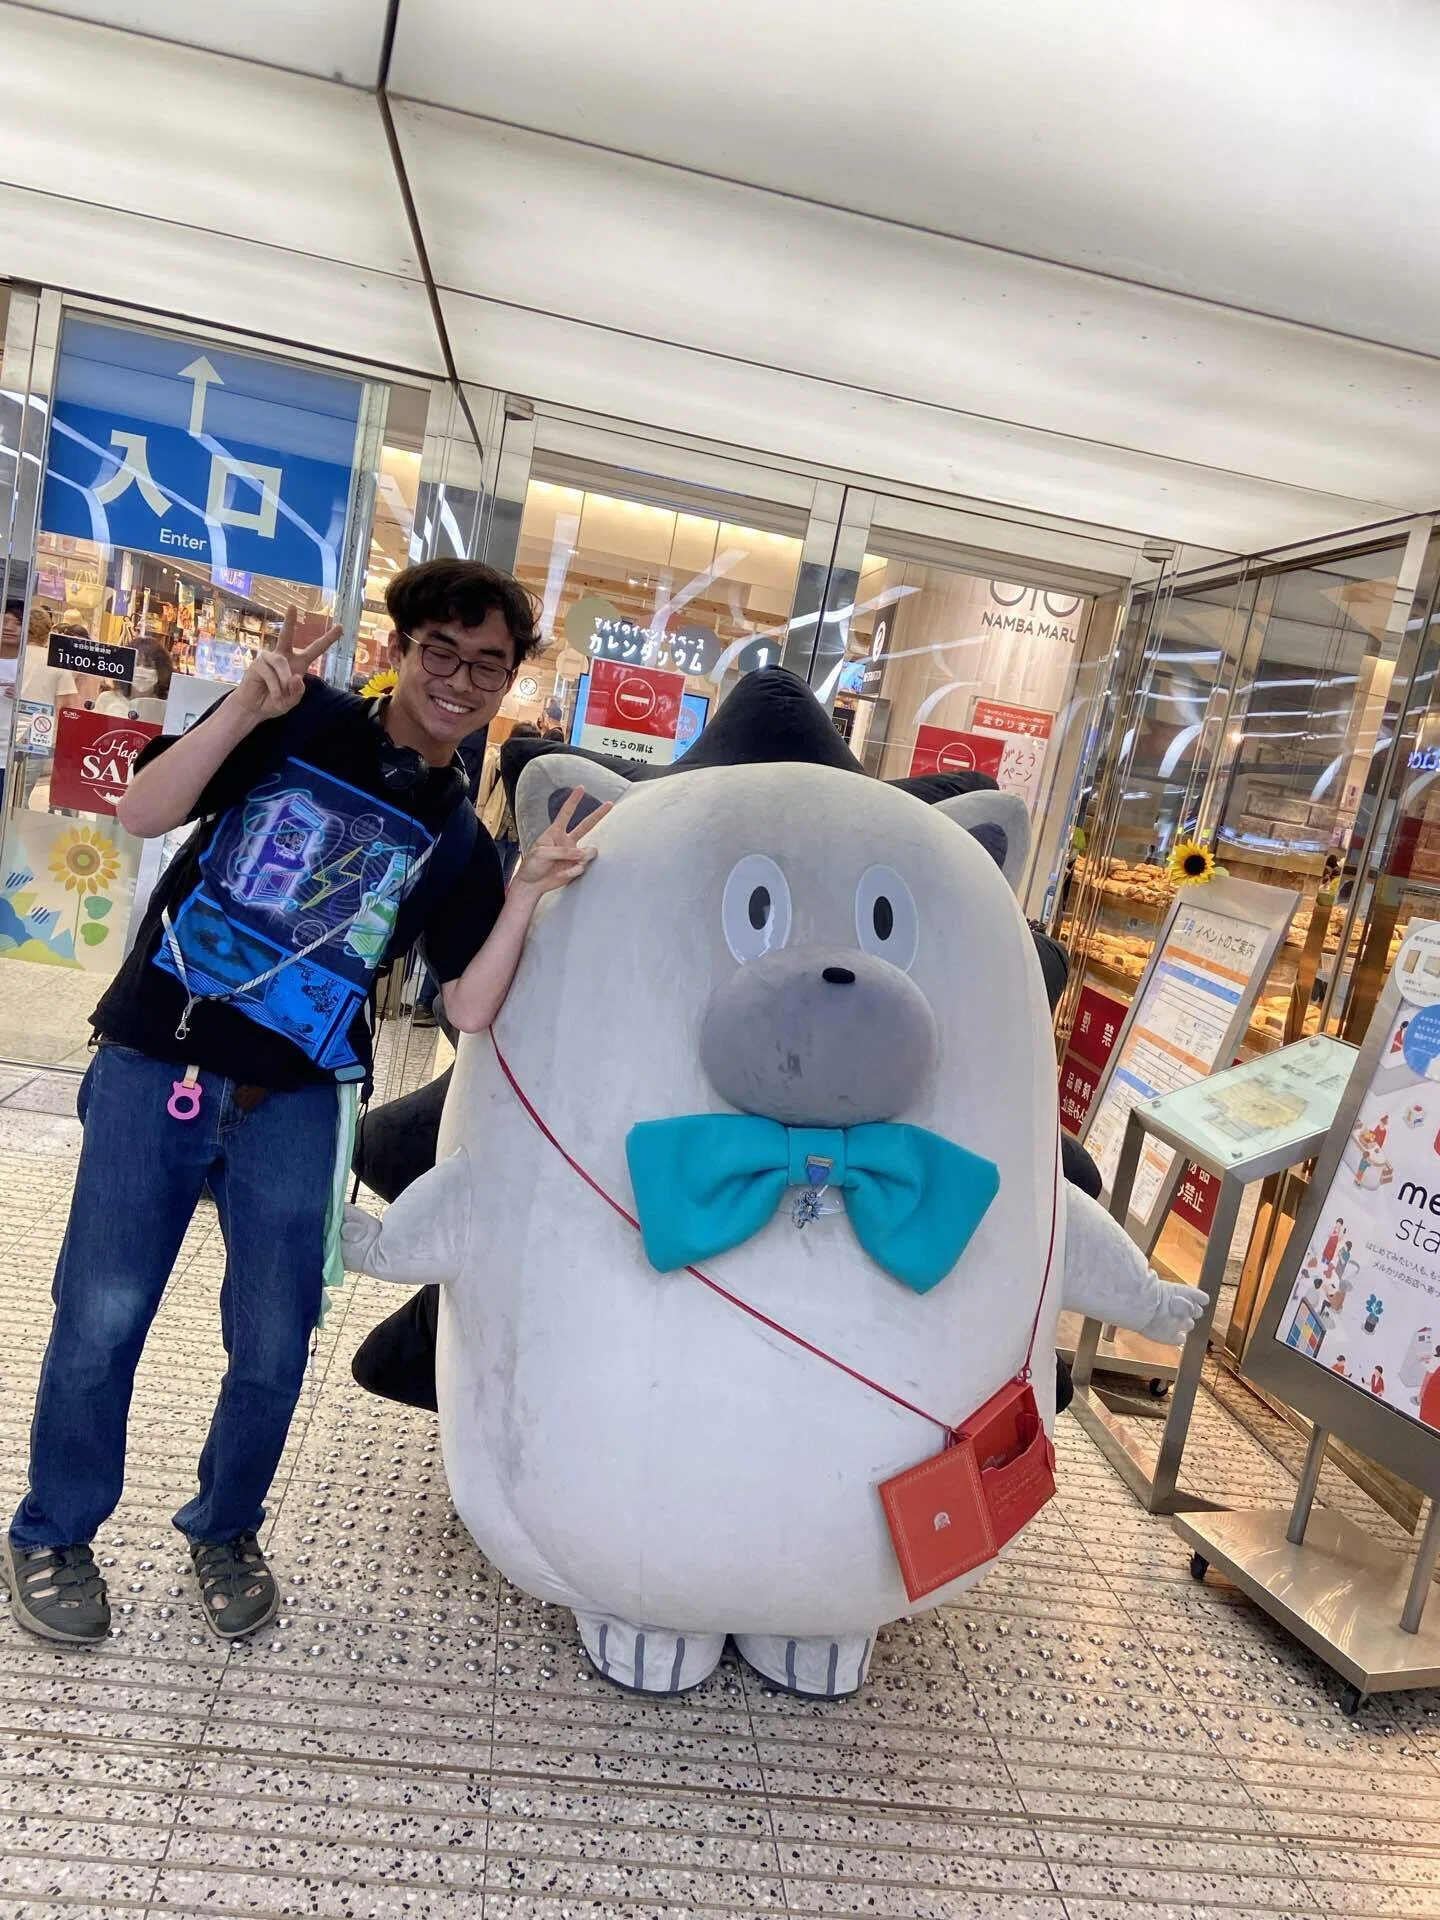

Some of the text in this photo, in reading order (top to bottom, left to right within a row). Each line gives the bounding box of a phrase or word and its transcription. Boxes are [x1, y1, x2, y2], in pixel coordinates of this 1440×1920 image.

[93, 429, 282, 539] 入口
[159, 527, 207, 551] Enter
[595, 616, 705, 650] マルイのイベントスペース
[981, 611, 1034, 636] NAMBA
[58, 652, 125, 675] 11:00 8:00
[589, 633, 702, 672] カレンダリウム
[757, 647, 769, 668] 1
[602, 737, 654, 754] こちらの扉は
[1395, 1218, 1440, 1254] sta
